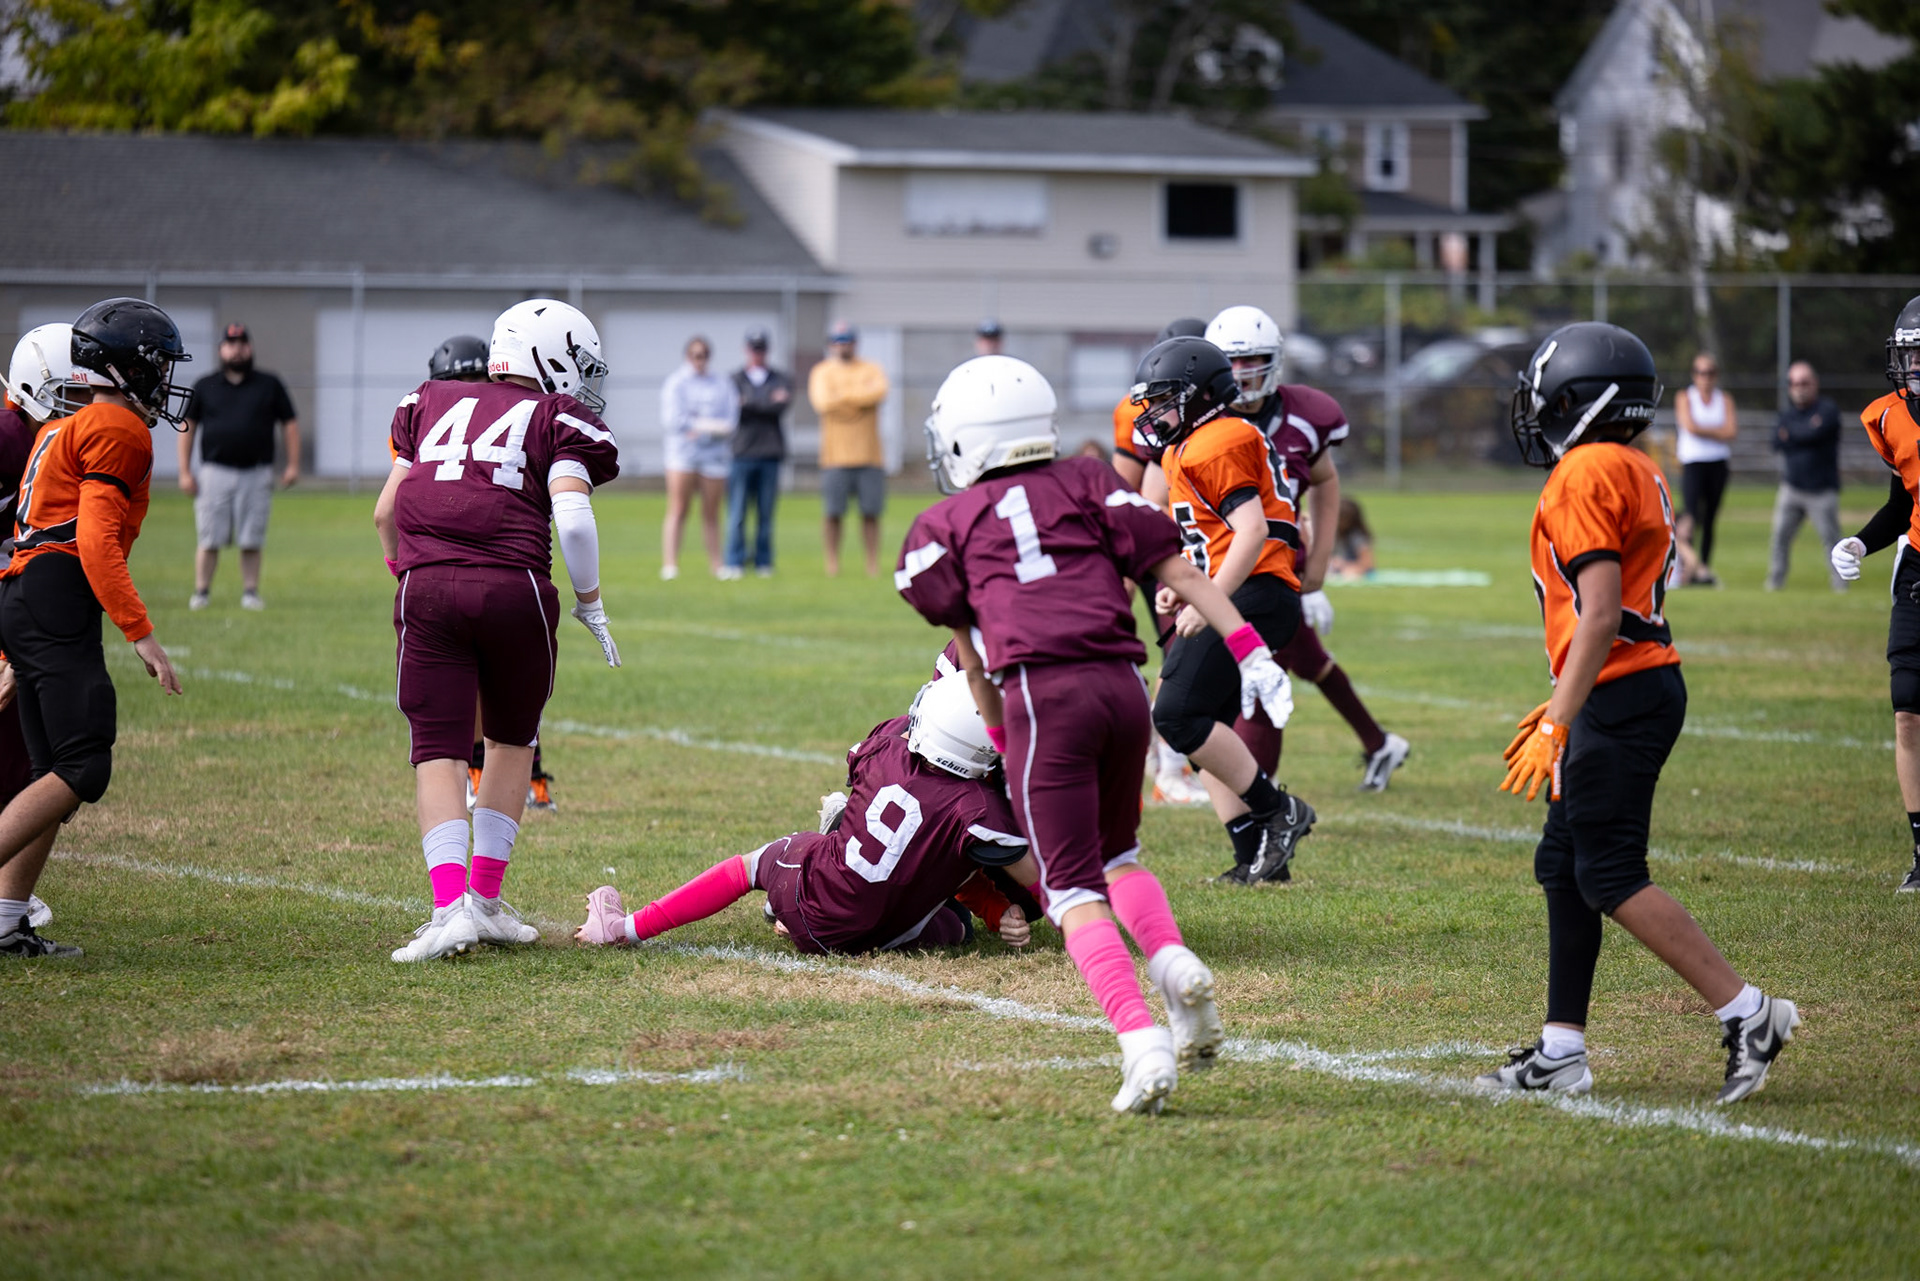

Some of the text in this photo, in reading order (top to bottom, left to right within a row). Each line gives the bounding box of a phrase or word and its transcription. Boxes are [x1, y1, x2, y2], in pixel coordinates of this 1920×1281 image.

[418, 397, 539, 490] 44
[995, 484, 1058, 584] 1
[935, 756, 970, 775] schutt
[845, 783, 923, 884] 9
